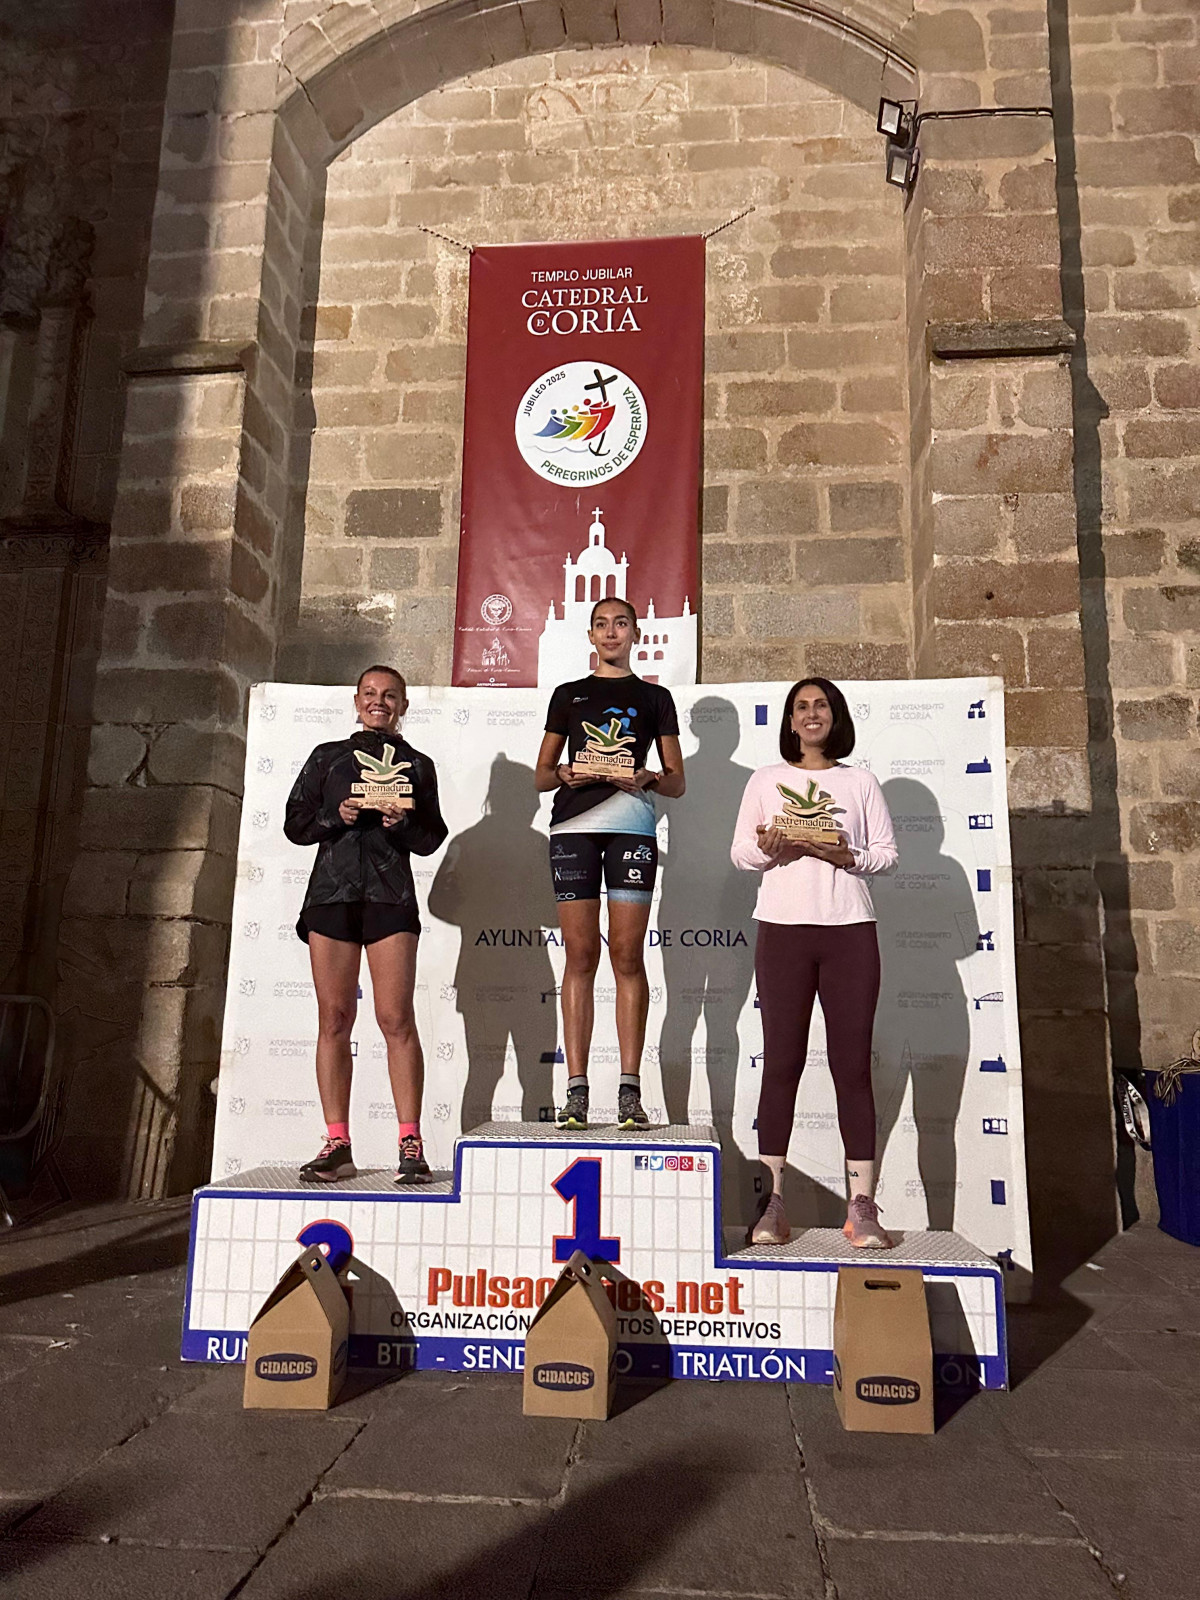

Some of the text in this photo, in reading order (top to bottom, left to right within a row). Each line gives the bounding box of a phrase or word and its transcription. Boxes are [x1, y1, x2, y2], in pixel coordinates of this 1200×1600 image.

[530, 267, 633, 283] TEMPLO JUBILAR
[521, 286, 649, 308] CATEDRAL
[527, 307, 641, 336] CORIA
[523, 371, 567, 417] JUBILEO 2025
[541, 387, 642, 481] PEREGRINOS DE ESPERANZA
[578, 753, 632, 765] Extremadura
[353, 783, 410, 792] Extremadura
[775, 815, 834, 828] Extremadura
[649, 929, 671, 947] DE
[680, 929, 748, 947] CORIA
[551, 1157, 620, 1264] 1
[391, 1310, 531, 1331] ORGANIZACIÓN
[660, 1318, 781, 1340] DEPORTIVOS
[259, 1360, 313, 1374] CIDACOS
[377, 1341, 420, 1366] BTT
[677, 1349, 806, 1380] TRIATLÓN
[537, 1369, 590, 1386] CIDACOS
[860, 1383, 916, 1399] CIDACOS
